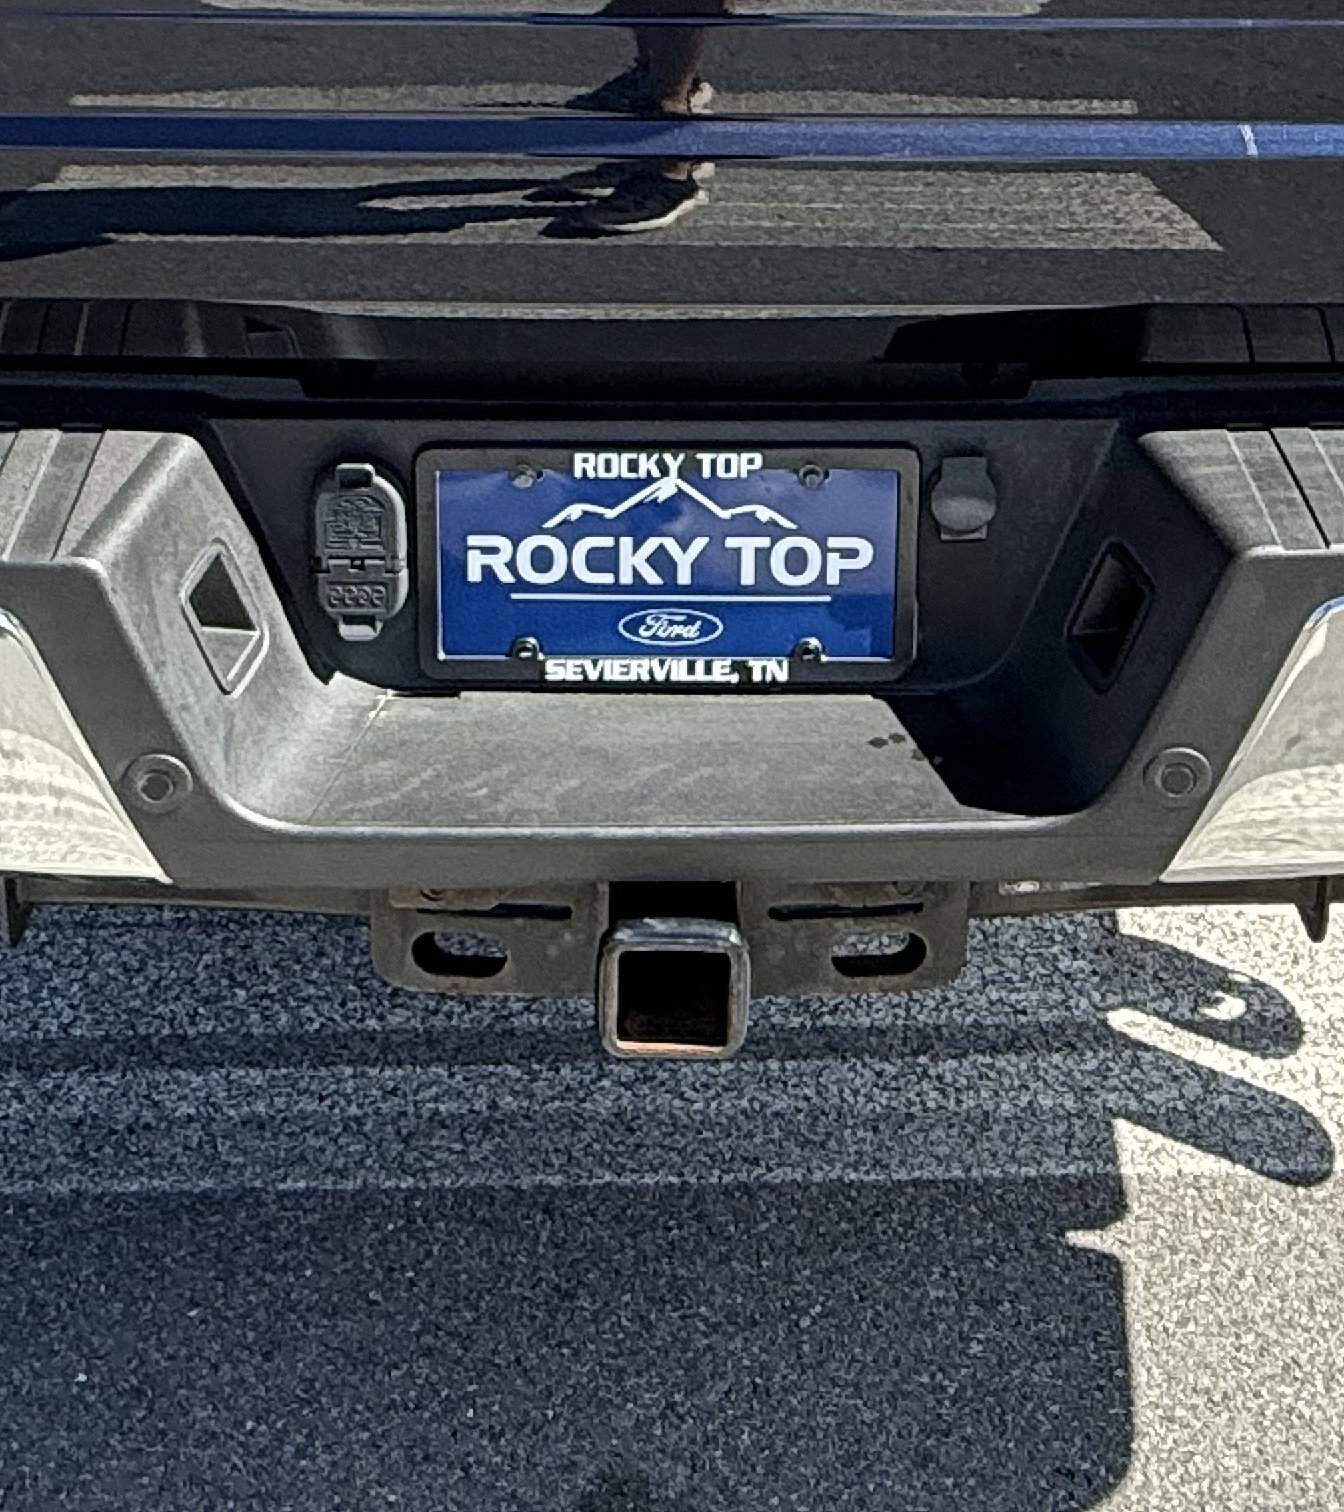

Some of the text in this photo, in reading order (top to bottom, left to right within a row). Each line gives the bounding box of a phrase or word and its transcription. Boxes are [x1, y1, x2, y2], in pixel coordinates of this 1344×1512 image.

[573, 451, 763, 480] ROCKY TOP
[465, 534, 875, 587] ROCKY TOP
[544, 657, 789, 685] SEVIERVILLE, TN
